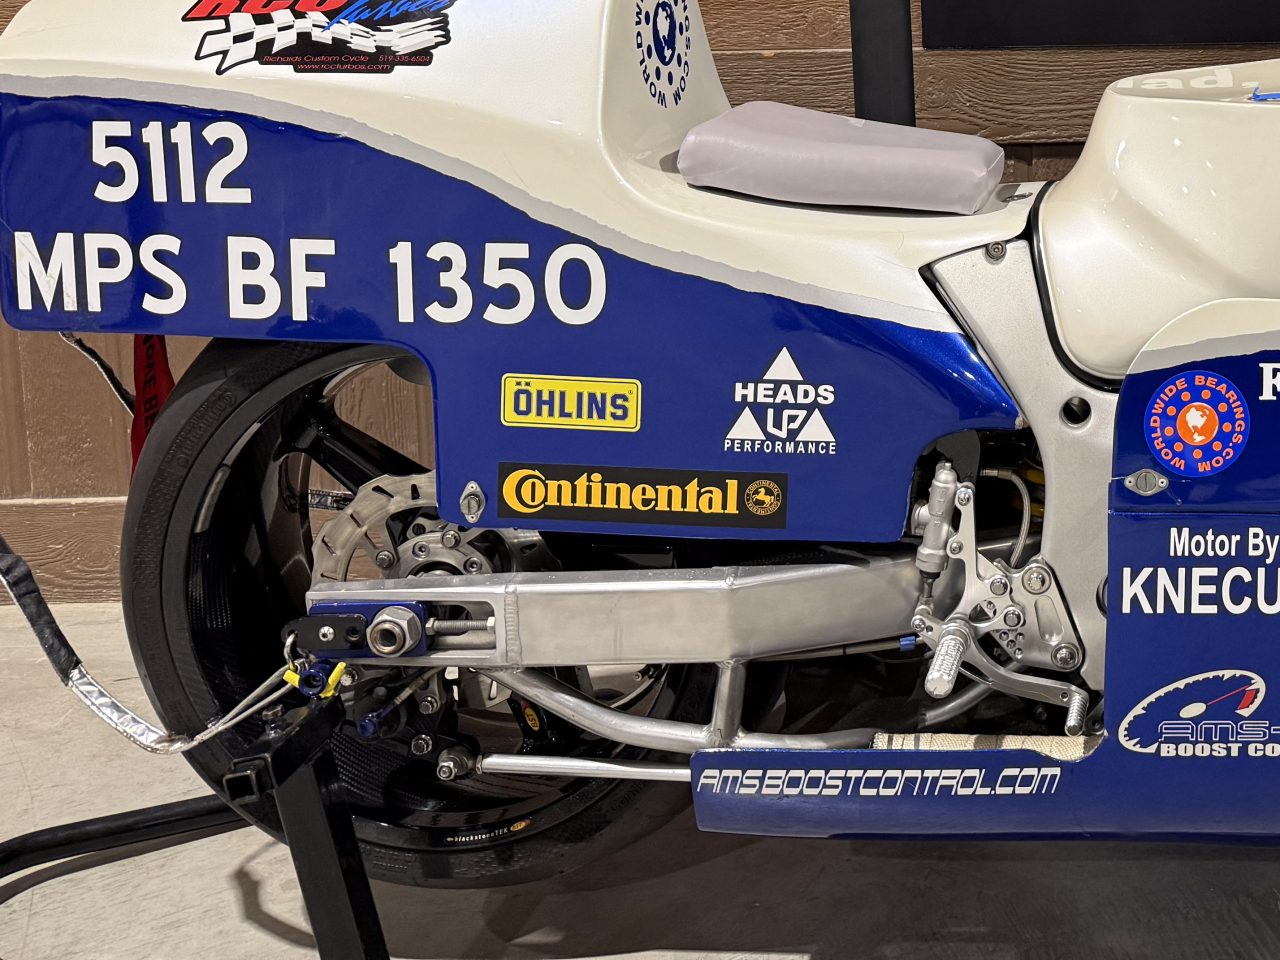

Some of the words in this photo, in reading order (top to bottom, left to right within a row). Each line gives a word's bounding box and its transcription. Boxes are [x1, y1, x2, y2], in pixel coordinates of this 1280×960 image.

[305, 54, 338, 62] Custom
[341, 54, 369, 64] Cycle
[92, 121, 252, 205] 5112
[14, 231, 187, 314] MPS
[227, 236, 335, 321] BF
[389, 241, 607, 325] 1350
[514, 381, 629, 420] ÖHLINS
[735, 382, 836, 405] HEADS
[766, 408, 808, 438] UP
[724, 440, 837, 455] PERFORMANCE
[502, 468, 739, 514] Continental
[1169, 527, 1240, 557] Motor
[1160, 743, 1242, 757] BOOST
